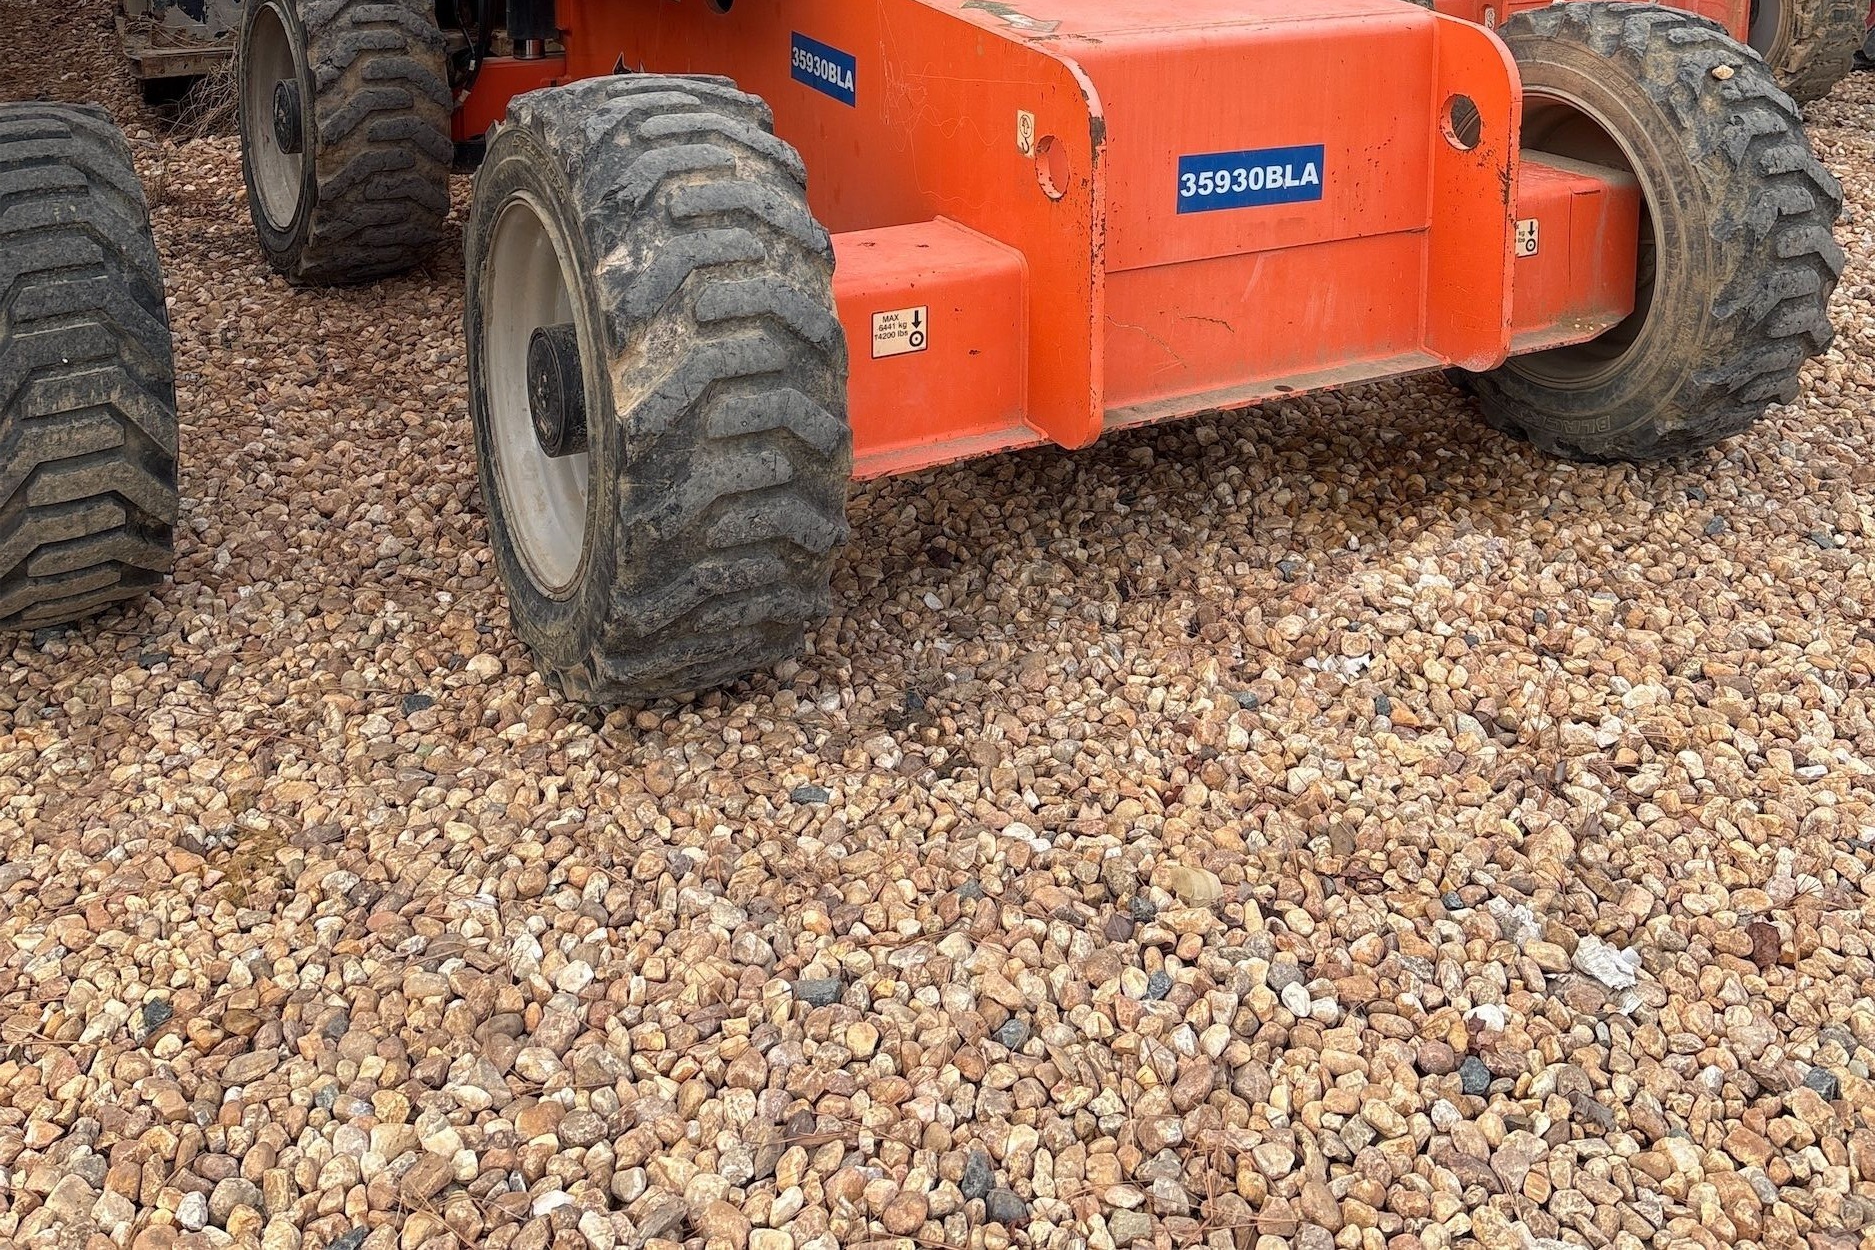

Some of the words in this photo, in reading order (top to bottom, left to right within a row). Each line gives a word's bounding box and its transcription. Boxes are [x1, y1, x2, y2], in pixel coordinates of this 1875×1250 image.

[792, 46, 855, 93] 35930BLA
[1180, 162, 1320, 198] 35930BLA
[882, 313, 900, 323] MAX
[898, 321, 908, 330] kg
[897, 330, 909, 338] lbs
